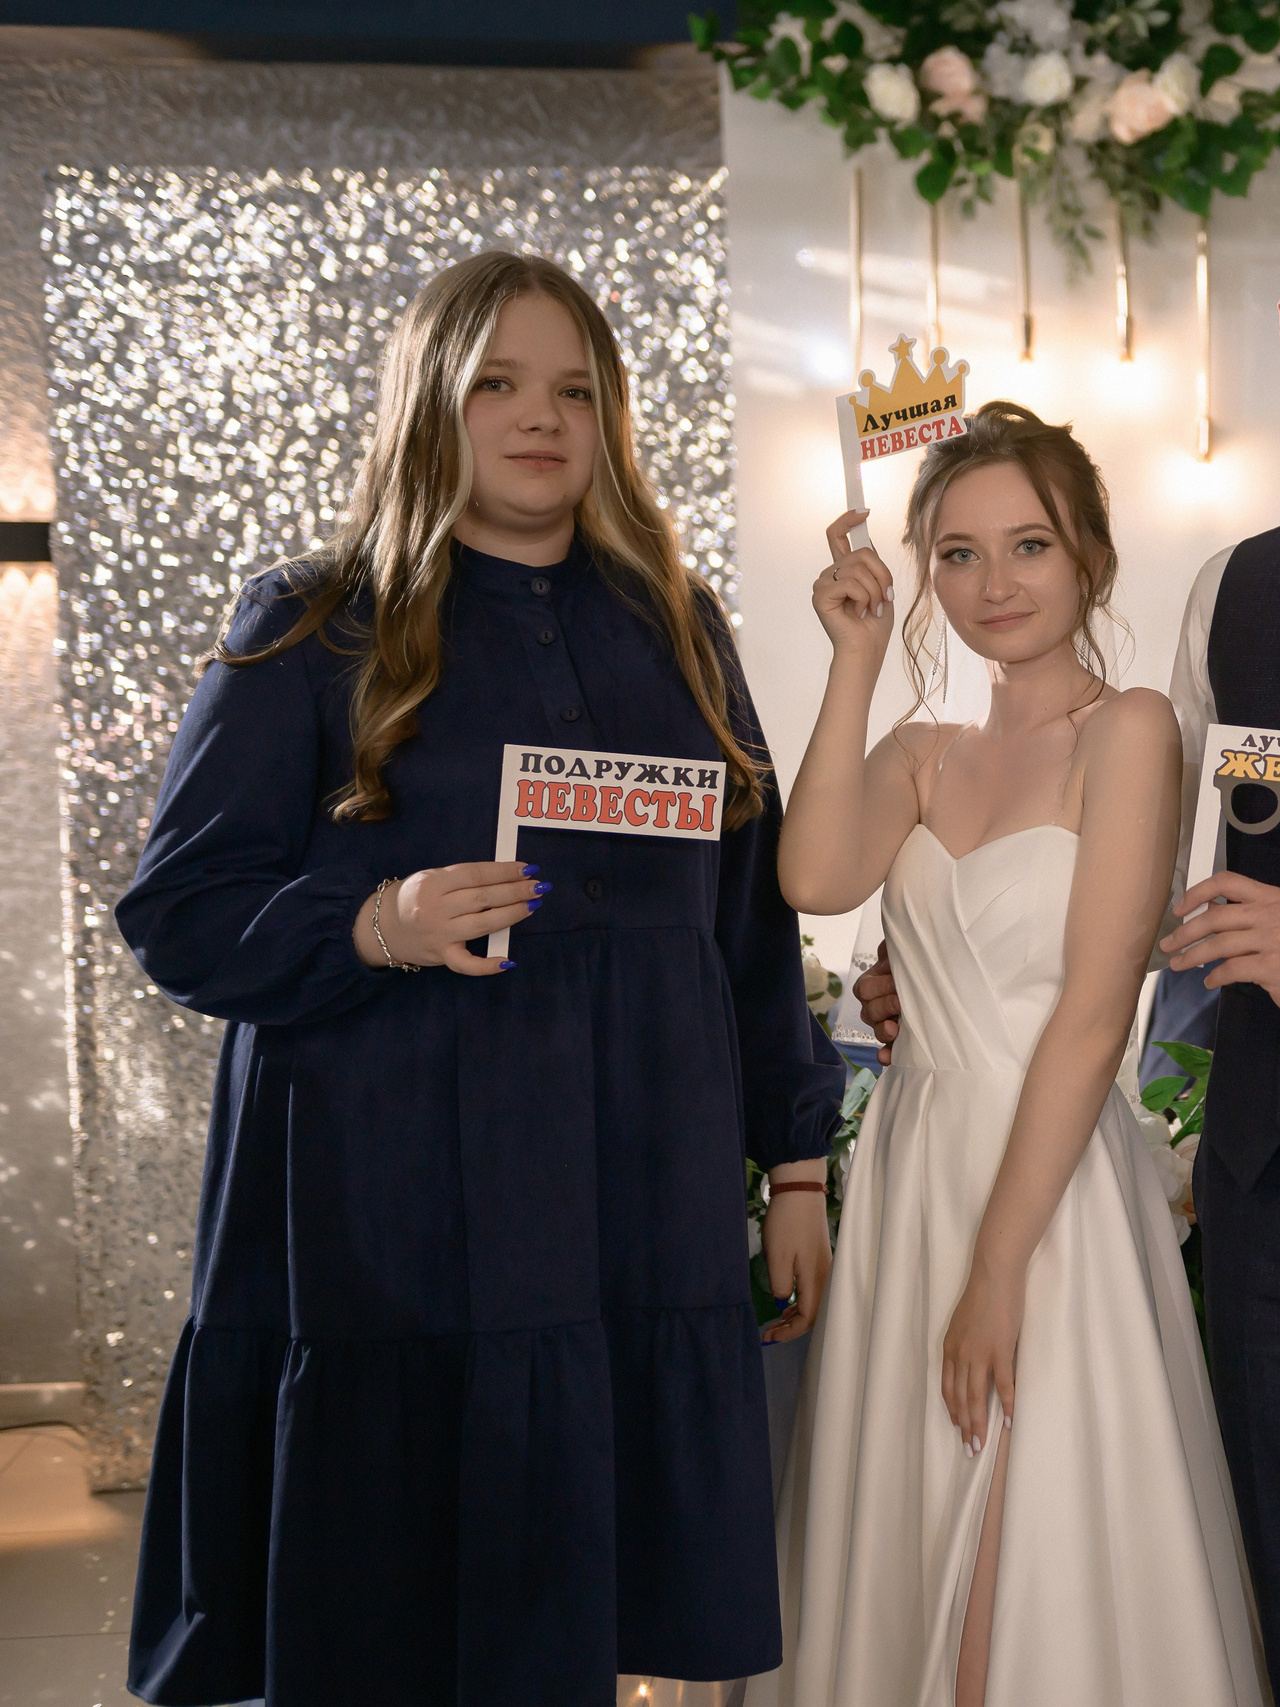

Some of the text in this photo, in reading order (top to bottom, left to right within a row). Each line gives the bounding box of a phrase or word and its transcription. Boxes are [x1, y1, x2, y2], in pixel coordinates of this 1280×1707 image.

[862, 394, 958, 432] Лучшая
[860, 415, 964, 461] НЕВЕСТА
[519, 752, 720, 790] ПОДРУЖКИ
[514, 779, 717, 832] НЕВЕСТЫ
